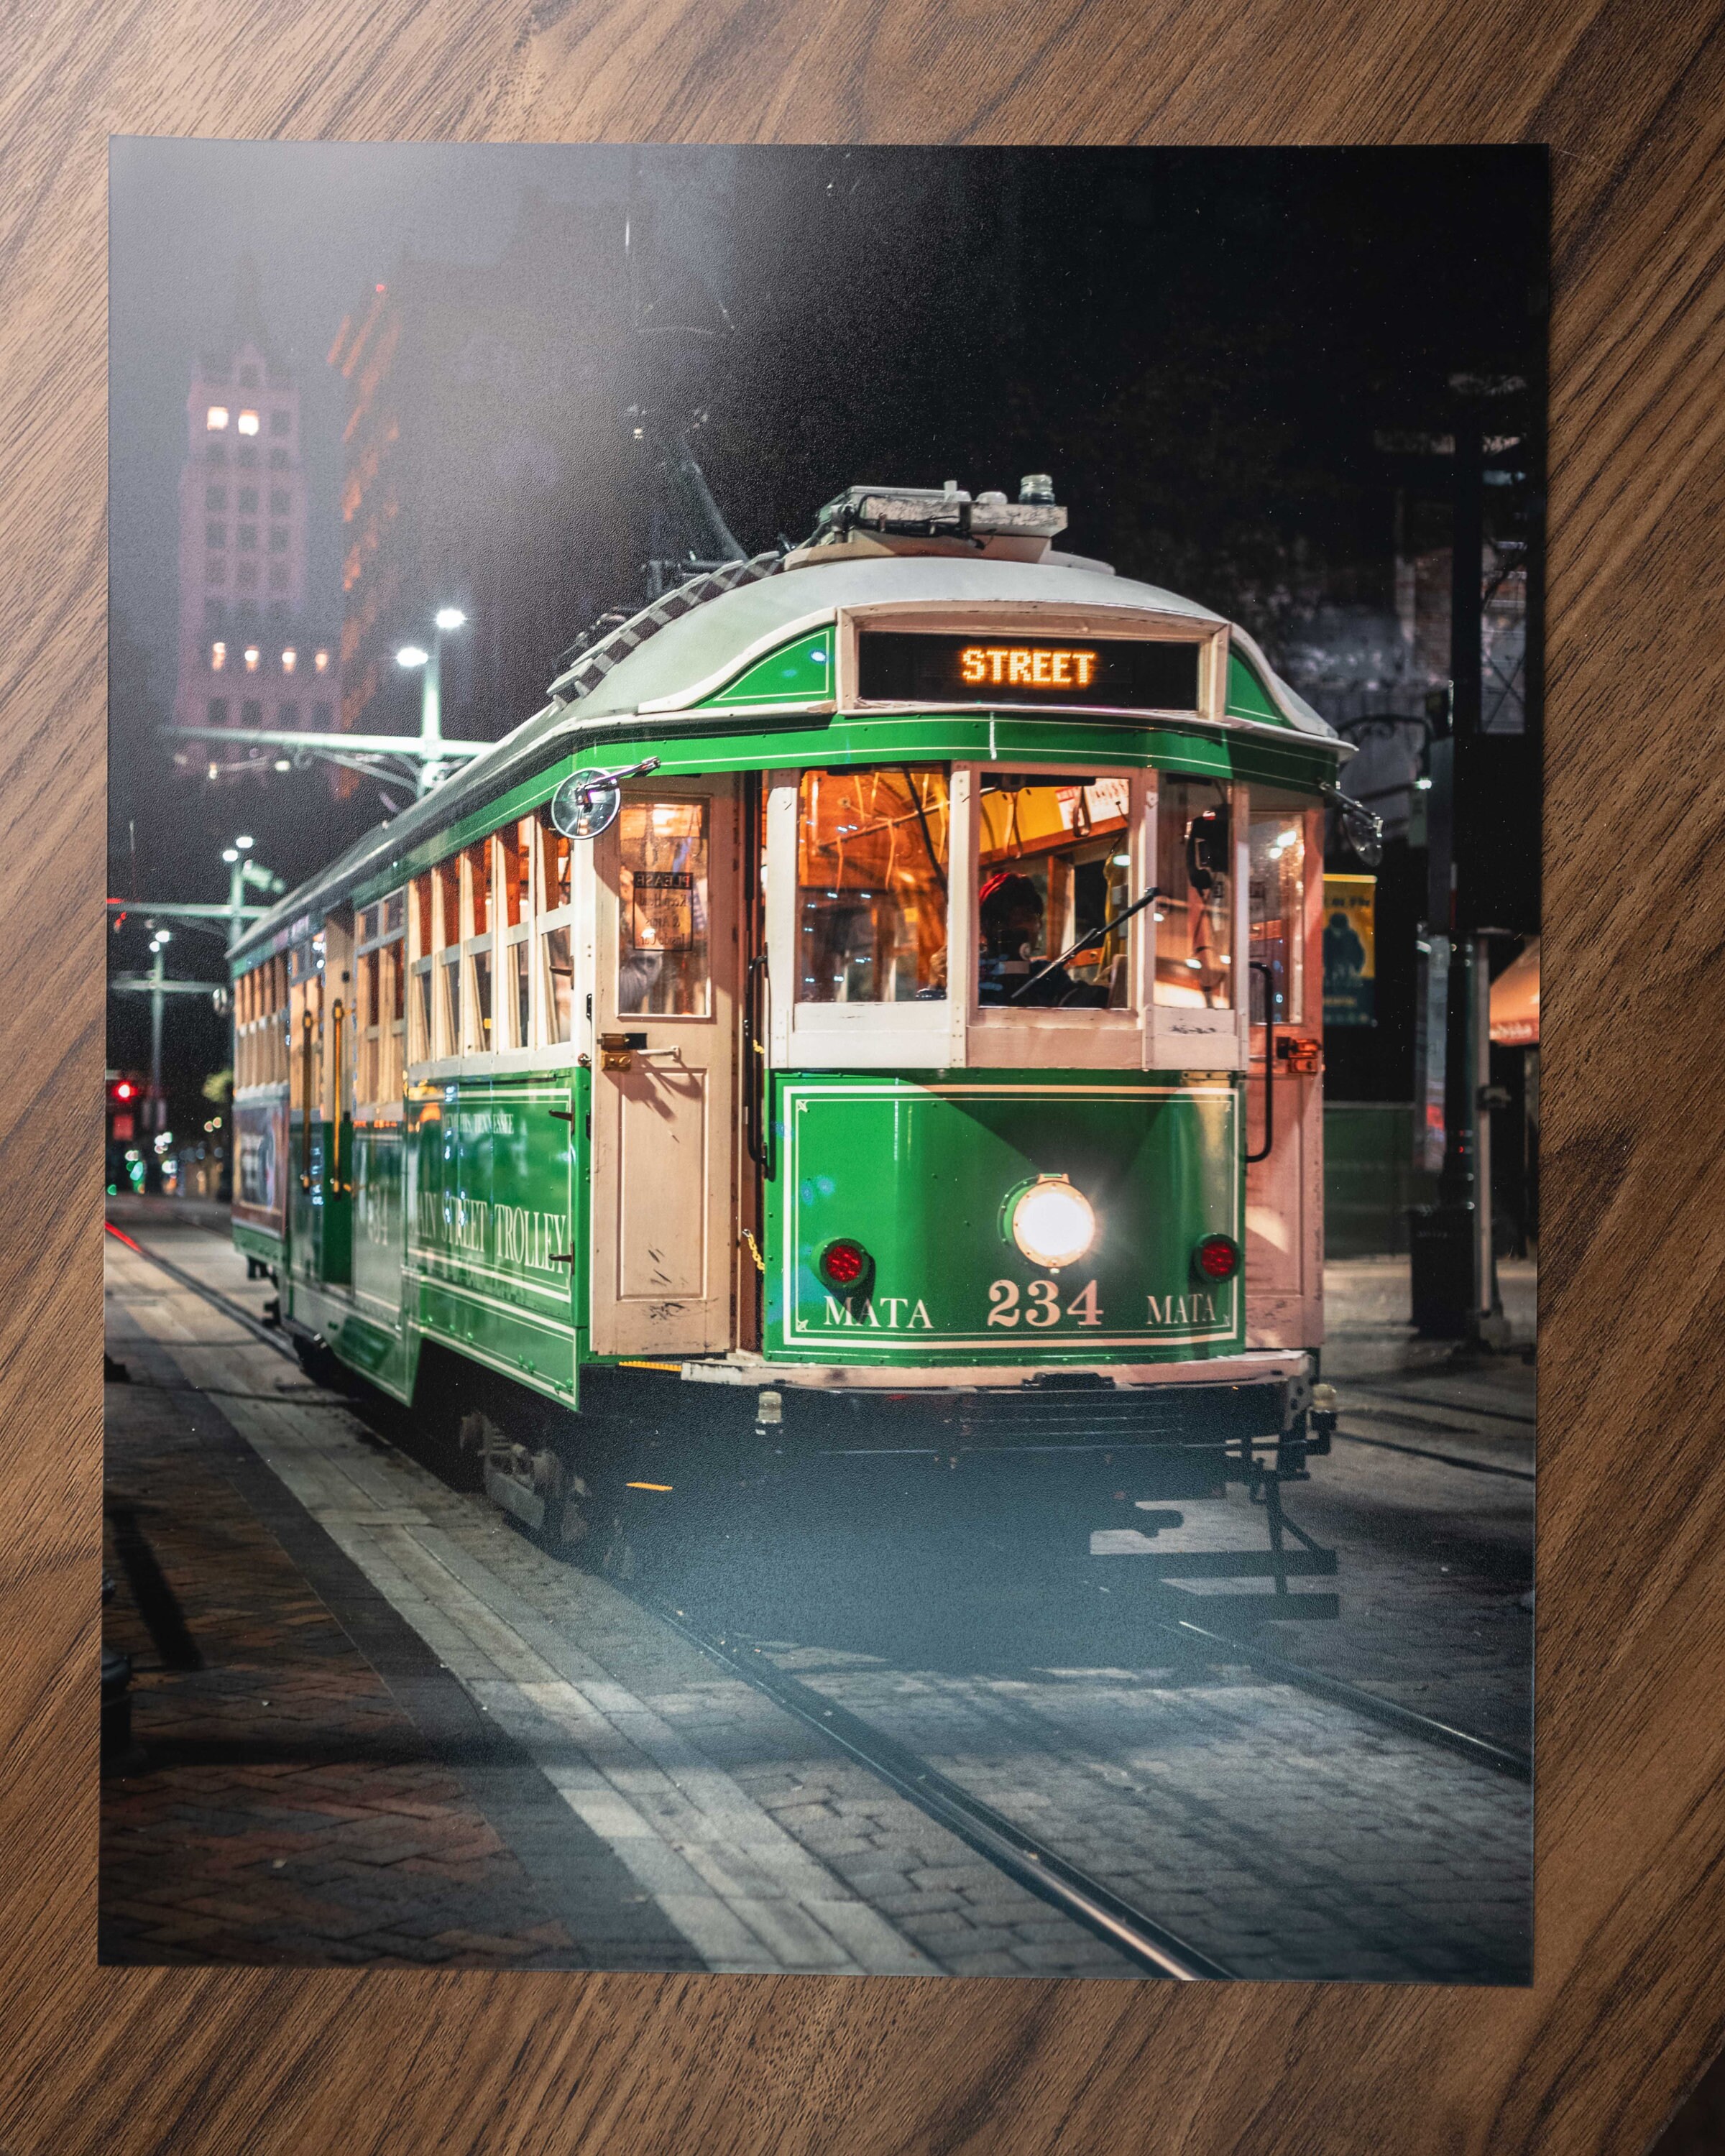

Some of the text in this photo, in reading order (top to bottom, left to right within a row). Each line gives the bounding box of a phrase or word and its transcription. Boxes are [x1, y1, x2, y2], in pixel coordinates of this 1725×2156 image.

[962, 648, 1096, 686] STREET
[441, 1192, 488, 1253] STREET
[494, 1203, 566, 1274] TROLLEY
[823, 1295, 934, 1330] MATA
[987, 1279, 1104, 1327] 234
[1146, 1294, 1217, 1325] MATA
